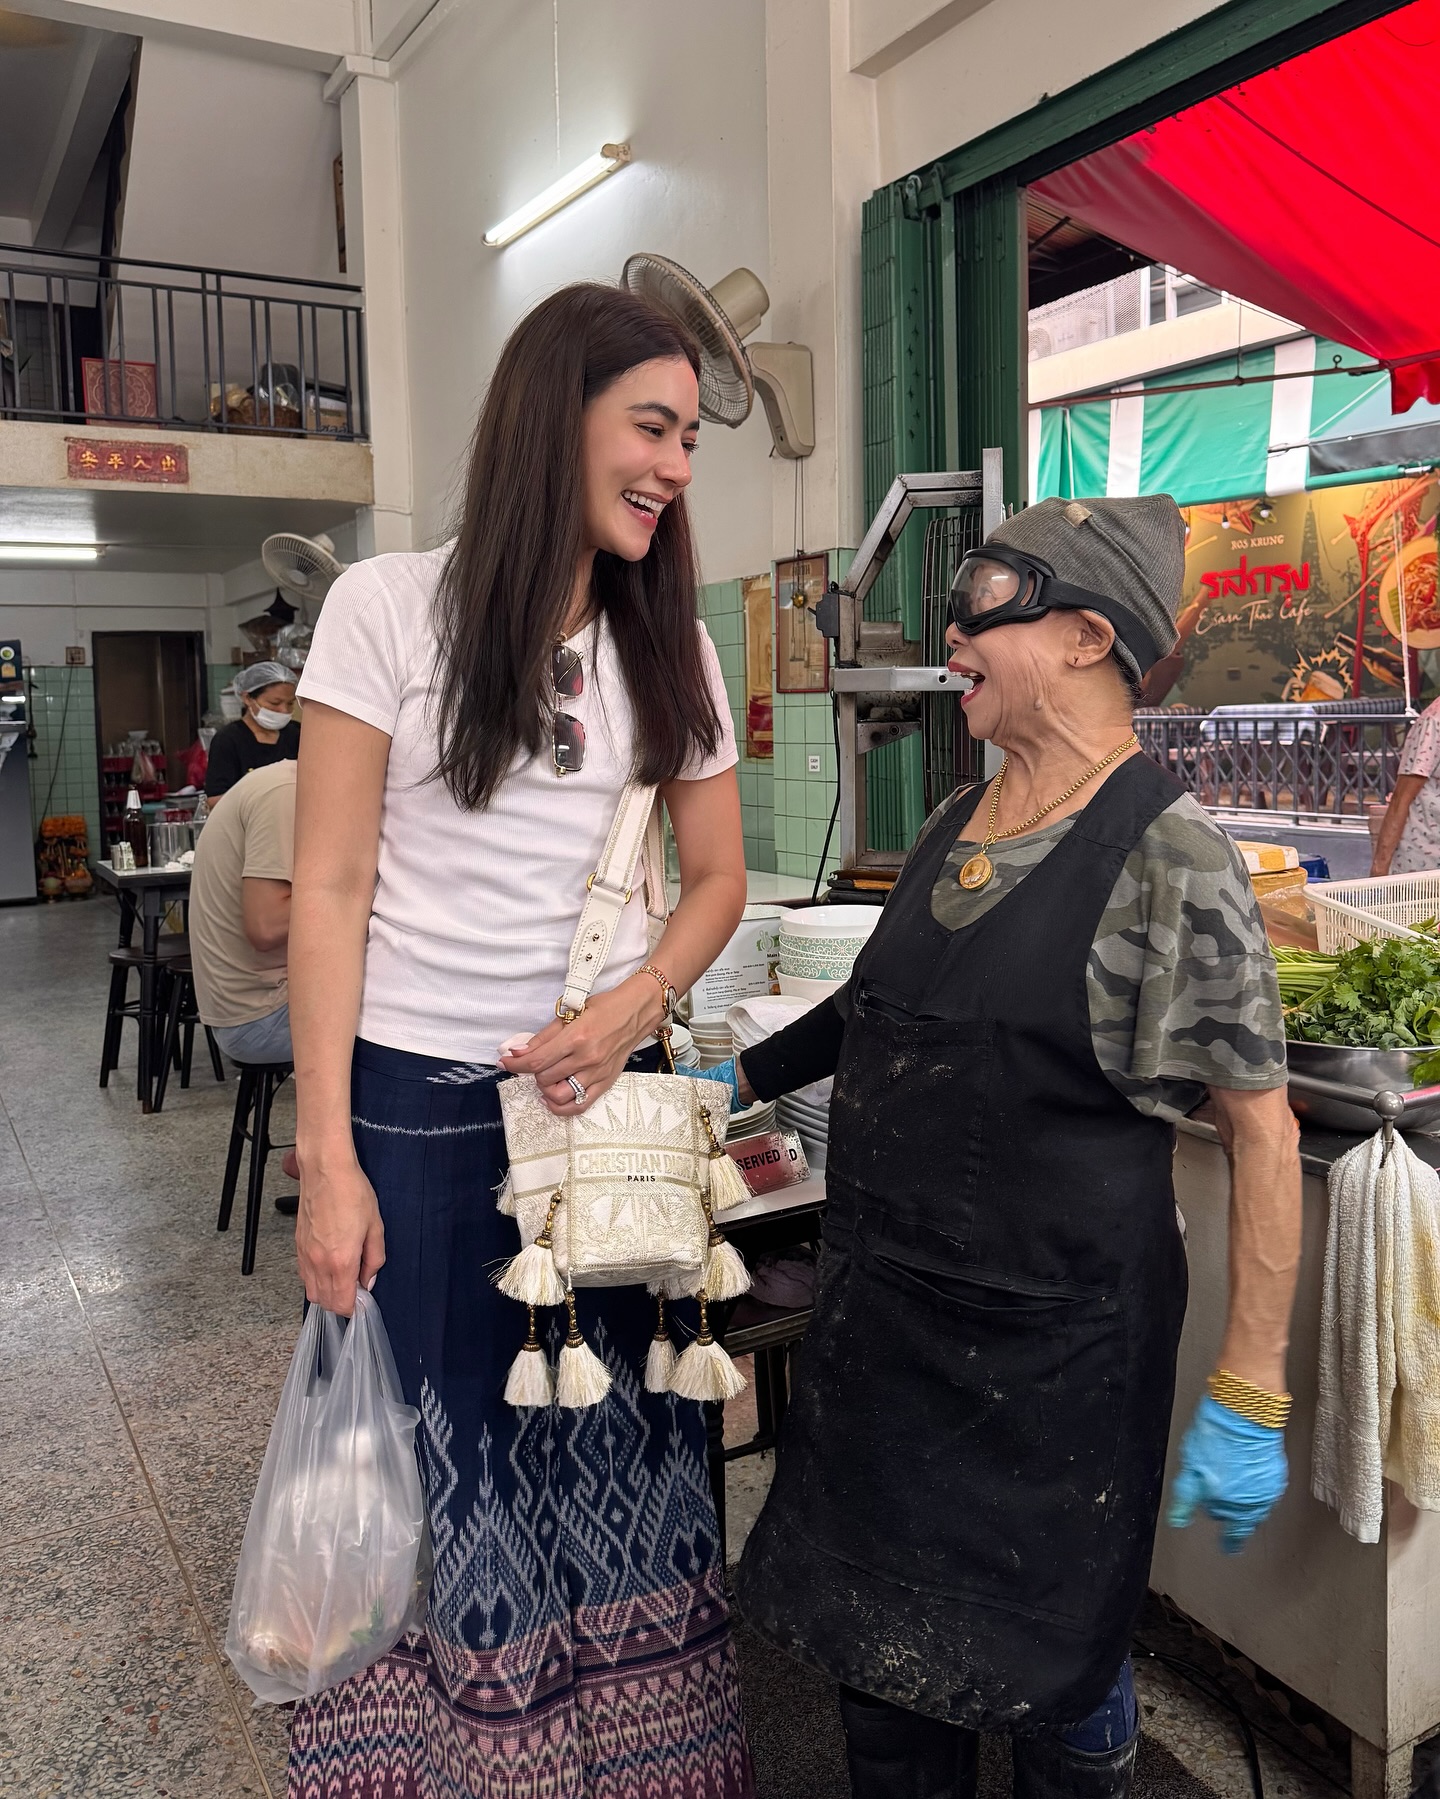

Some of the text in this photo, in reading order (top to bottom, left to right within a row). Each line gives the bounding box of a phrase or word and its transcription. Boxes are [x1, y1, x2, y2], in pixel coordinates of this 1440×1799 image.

[1250, 534, 1285, 548] KRUNG
[1240, 599, 1273, 630] Thai
[1279, 597, 1314, 625] Cafe
[578, 1151, 693, 1179] CHRISTIAN DIOR
